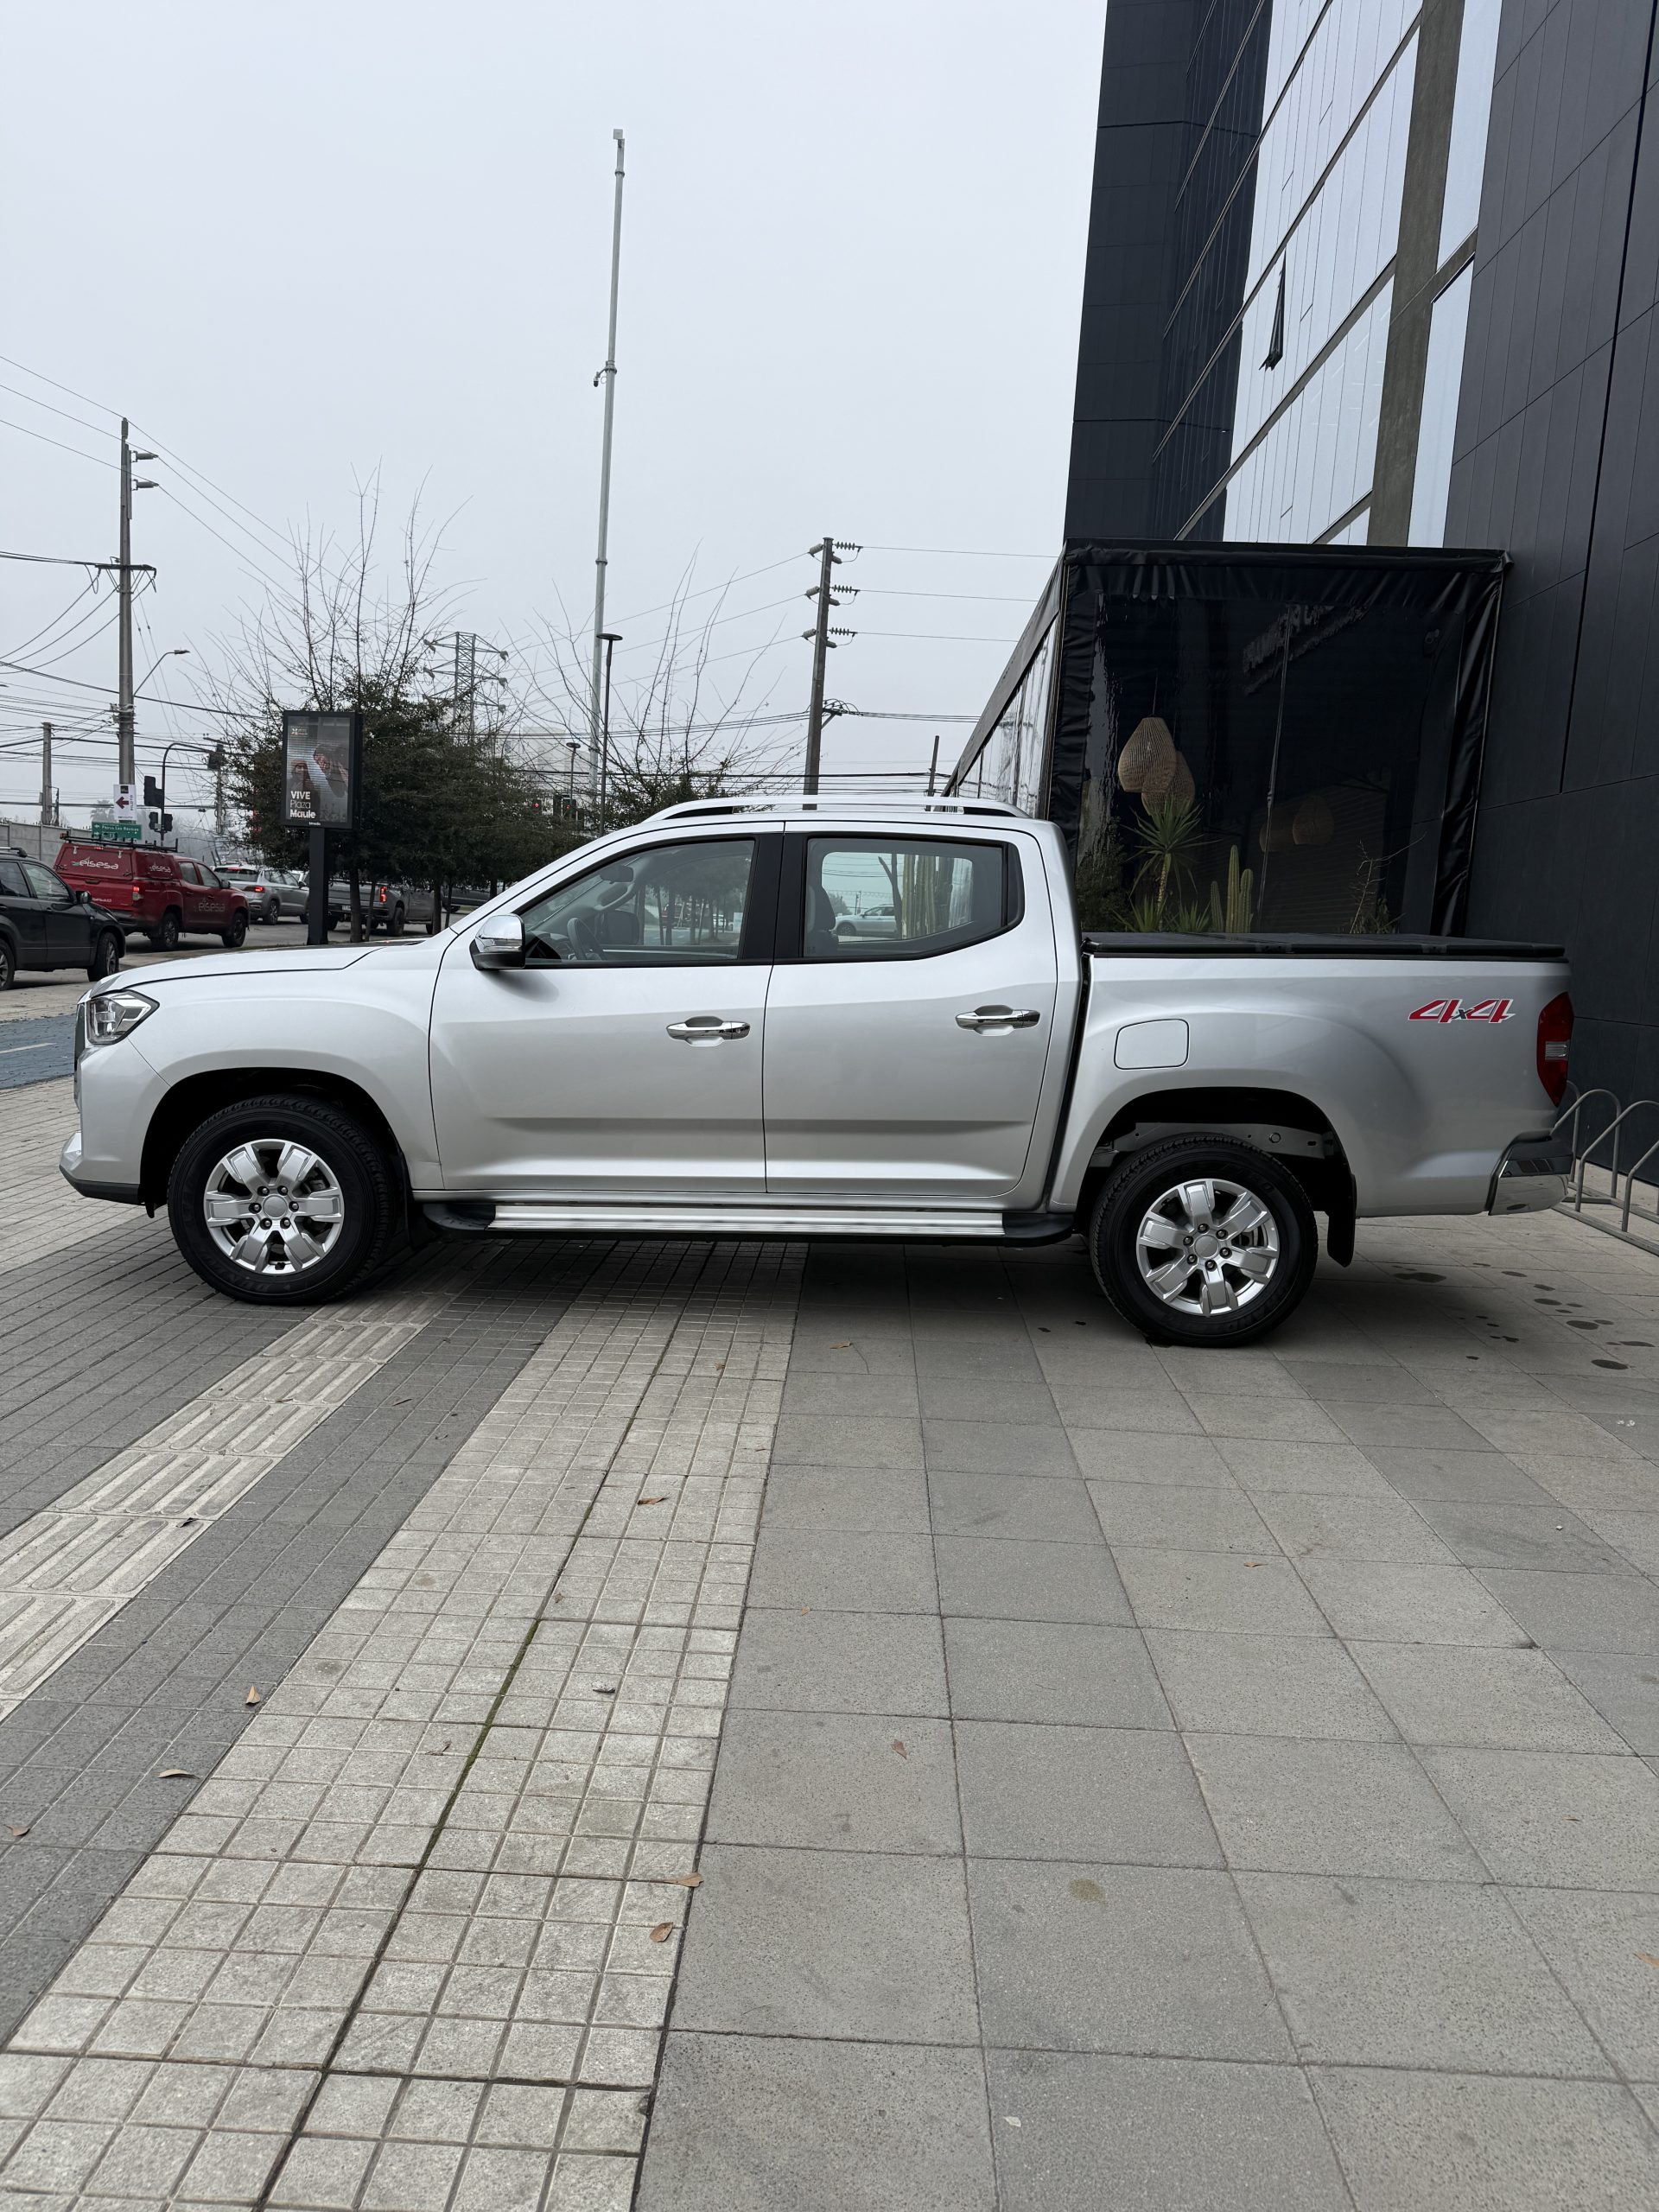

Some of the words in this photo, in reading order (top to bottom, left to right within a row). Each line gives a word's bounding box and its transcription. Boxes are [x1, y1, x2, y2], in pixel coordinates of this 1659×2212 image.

[290, 791, 311, 800] VIVE
[289, 800, 311, 809] Plaza
[289, 809, 316, 818] Maule
[1408, 998, 1516, 1024] 4x4
